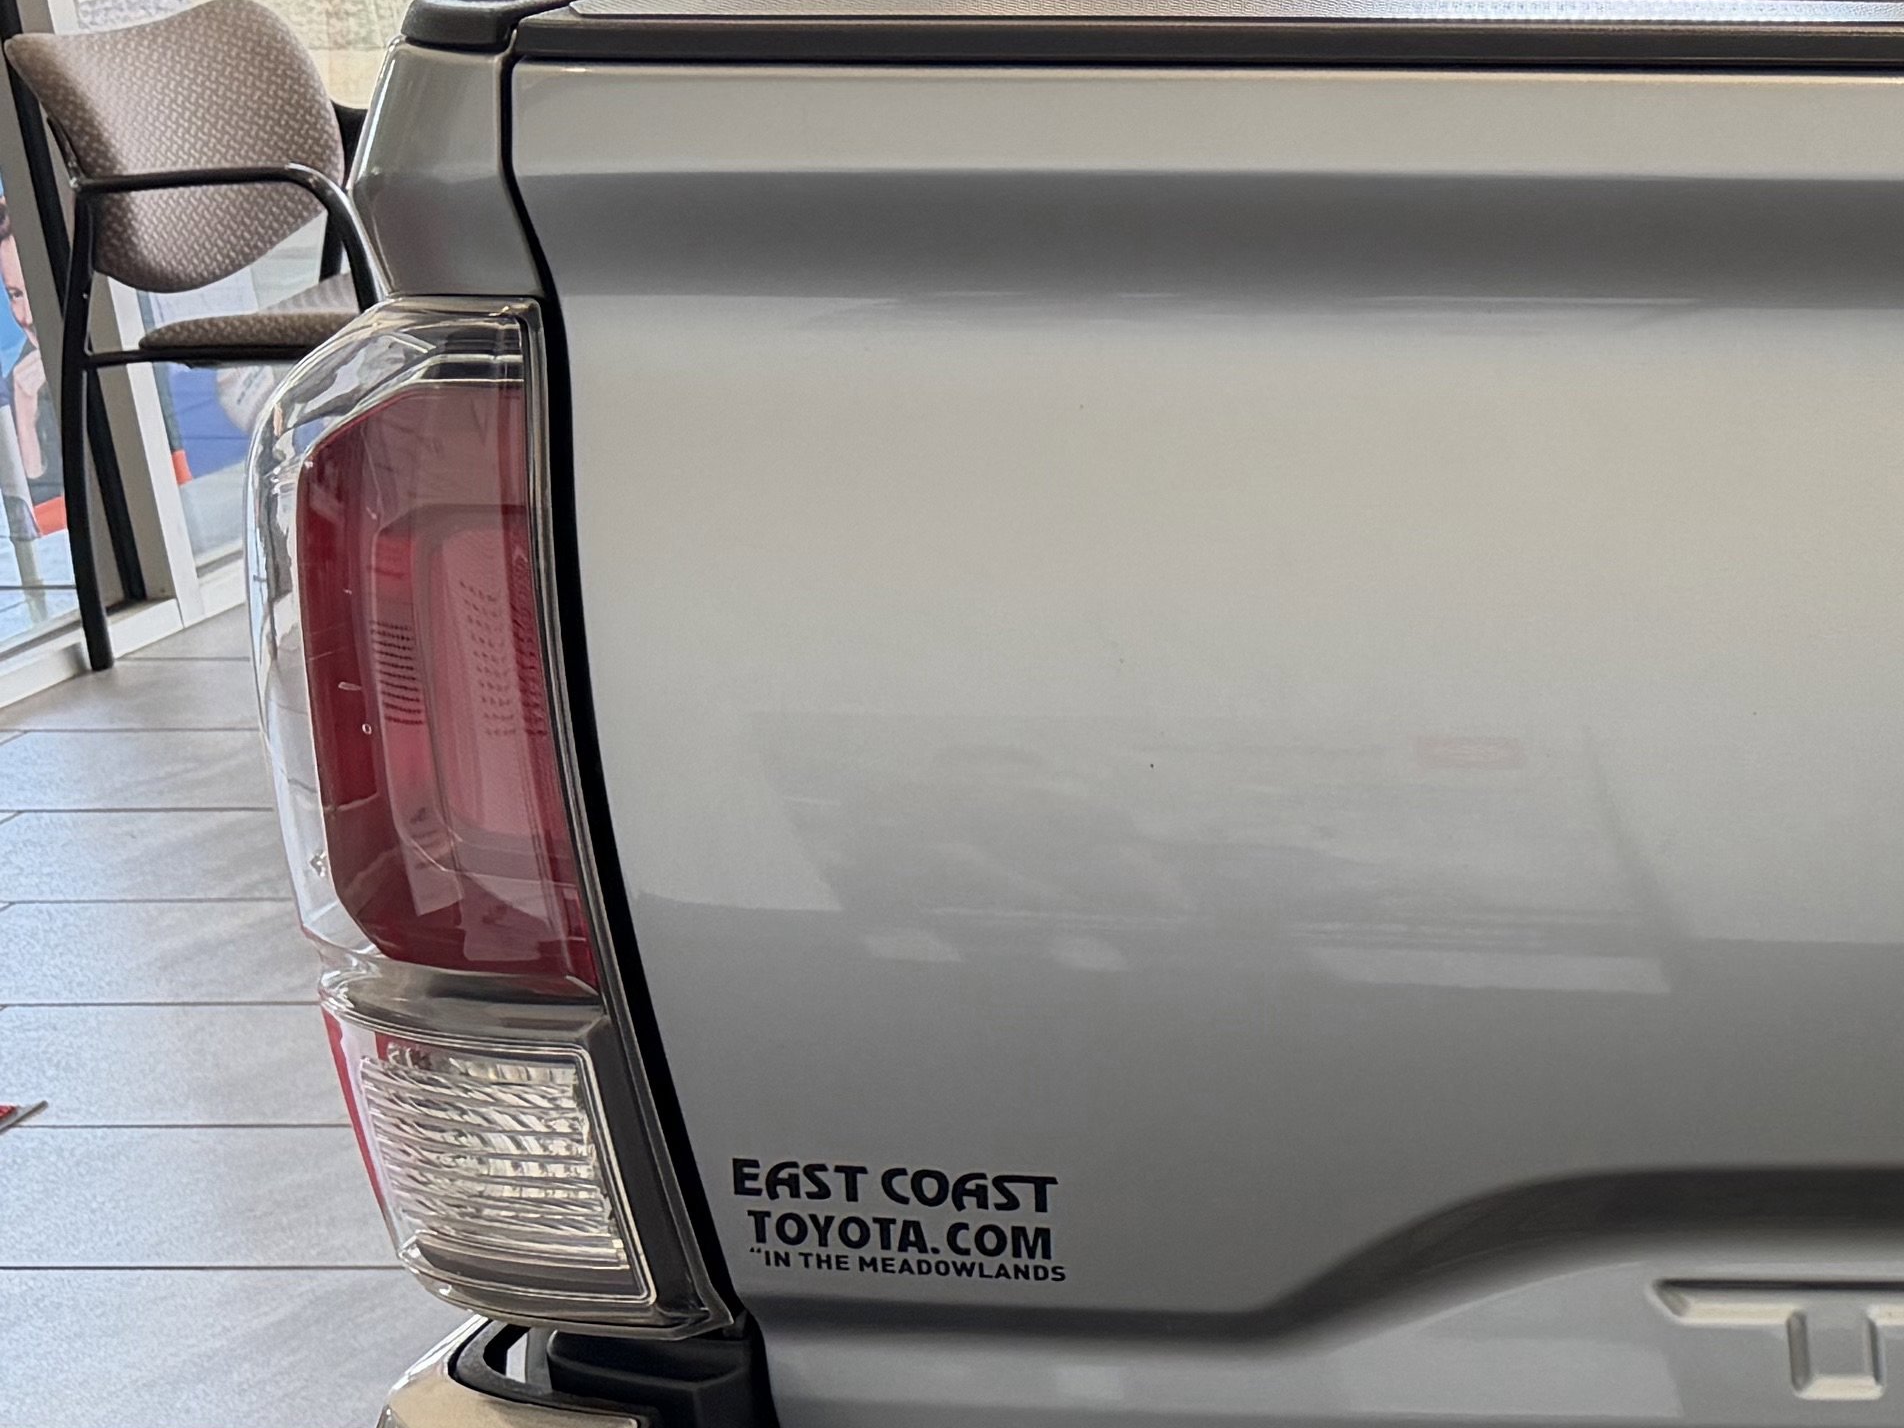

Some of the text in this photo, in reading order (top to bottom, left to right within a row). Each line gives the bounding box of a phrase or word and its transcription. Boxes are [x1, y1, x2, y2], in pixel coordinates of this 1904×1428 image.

[732, 1157, 1058, 1213] EAST COAST
[747, 1209, 1053, 1260] TOYOTA.COM
[798, 1251, 850, 1271] THE
[858, 1255, 1066, 1282] MEADOWLANDS
